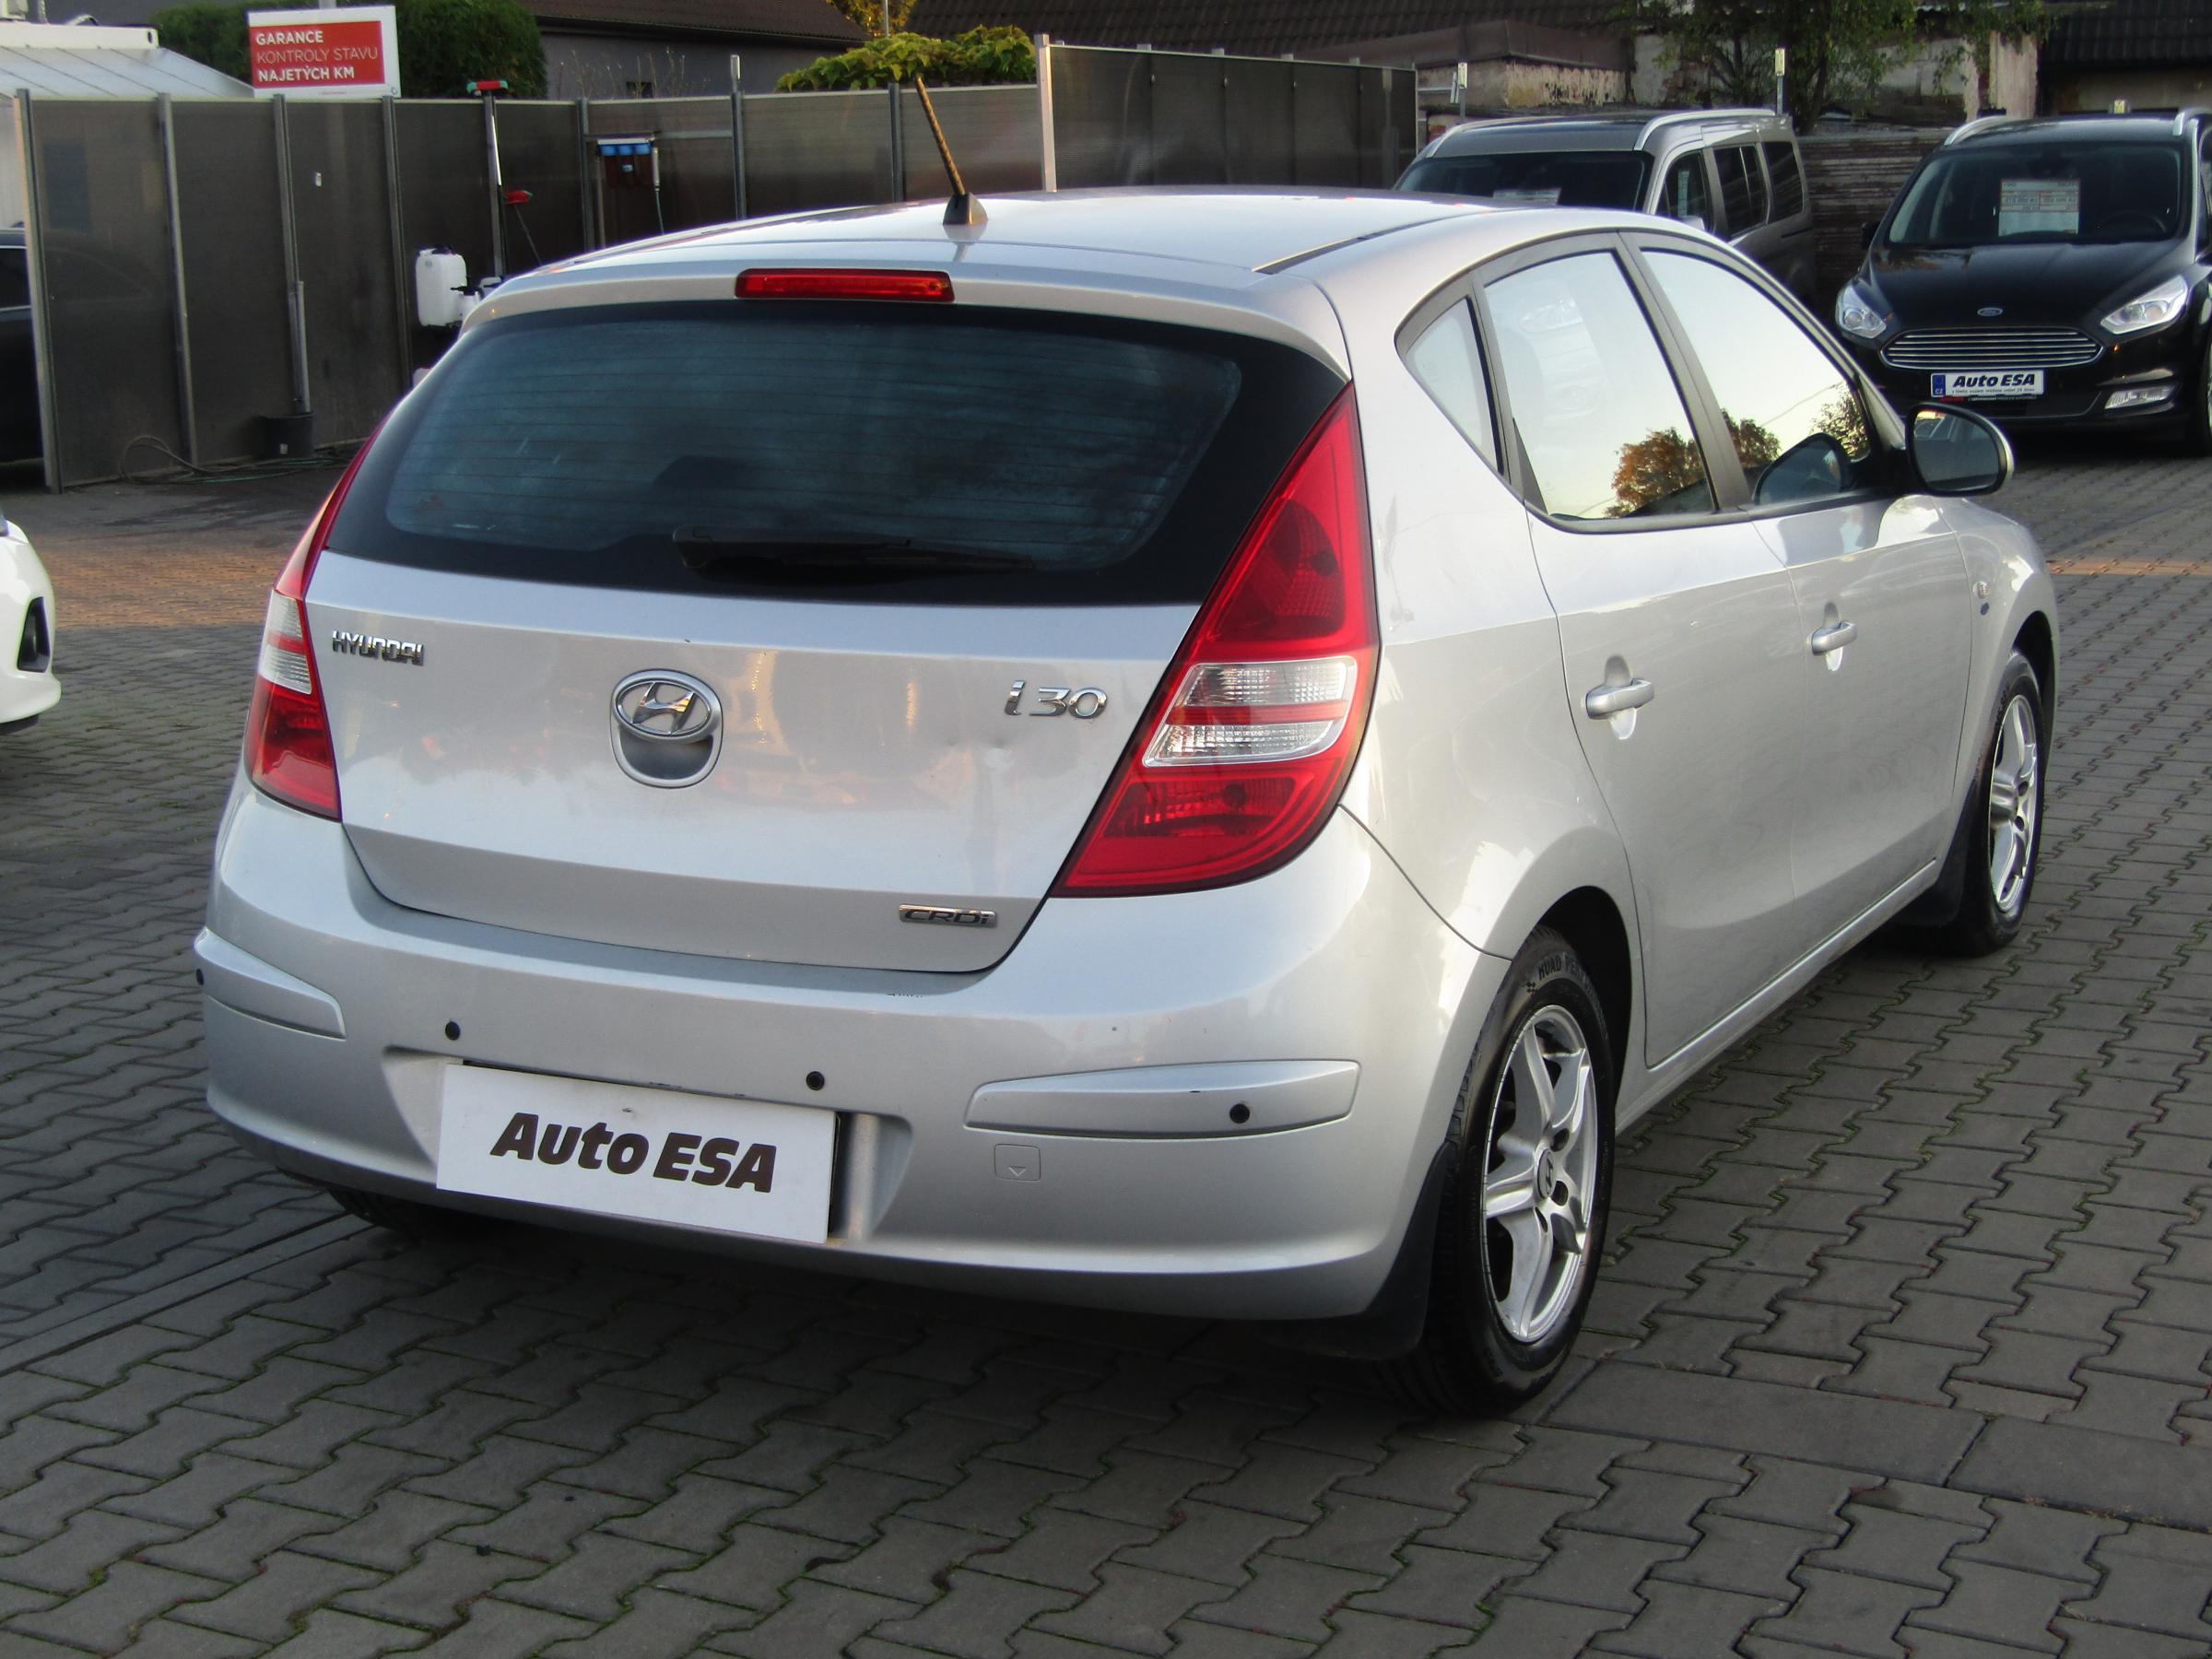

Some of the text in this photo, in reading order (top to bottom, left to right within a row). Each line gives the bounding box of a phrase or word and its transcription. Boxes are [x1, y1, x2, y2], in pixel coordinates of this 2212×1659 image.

[256, 30, 324, 45] GARANCE
[257, 47, 378, 64] KONTROLY STAVU
[258, 65, 355, 82] NAJETÝCH KM
[1952, 373, 2035, 388] Auto ESA
[333, 630, 424, 666] HYUNDAI
[489, 1112, 776, 1194] Auto ESA
